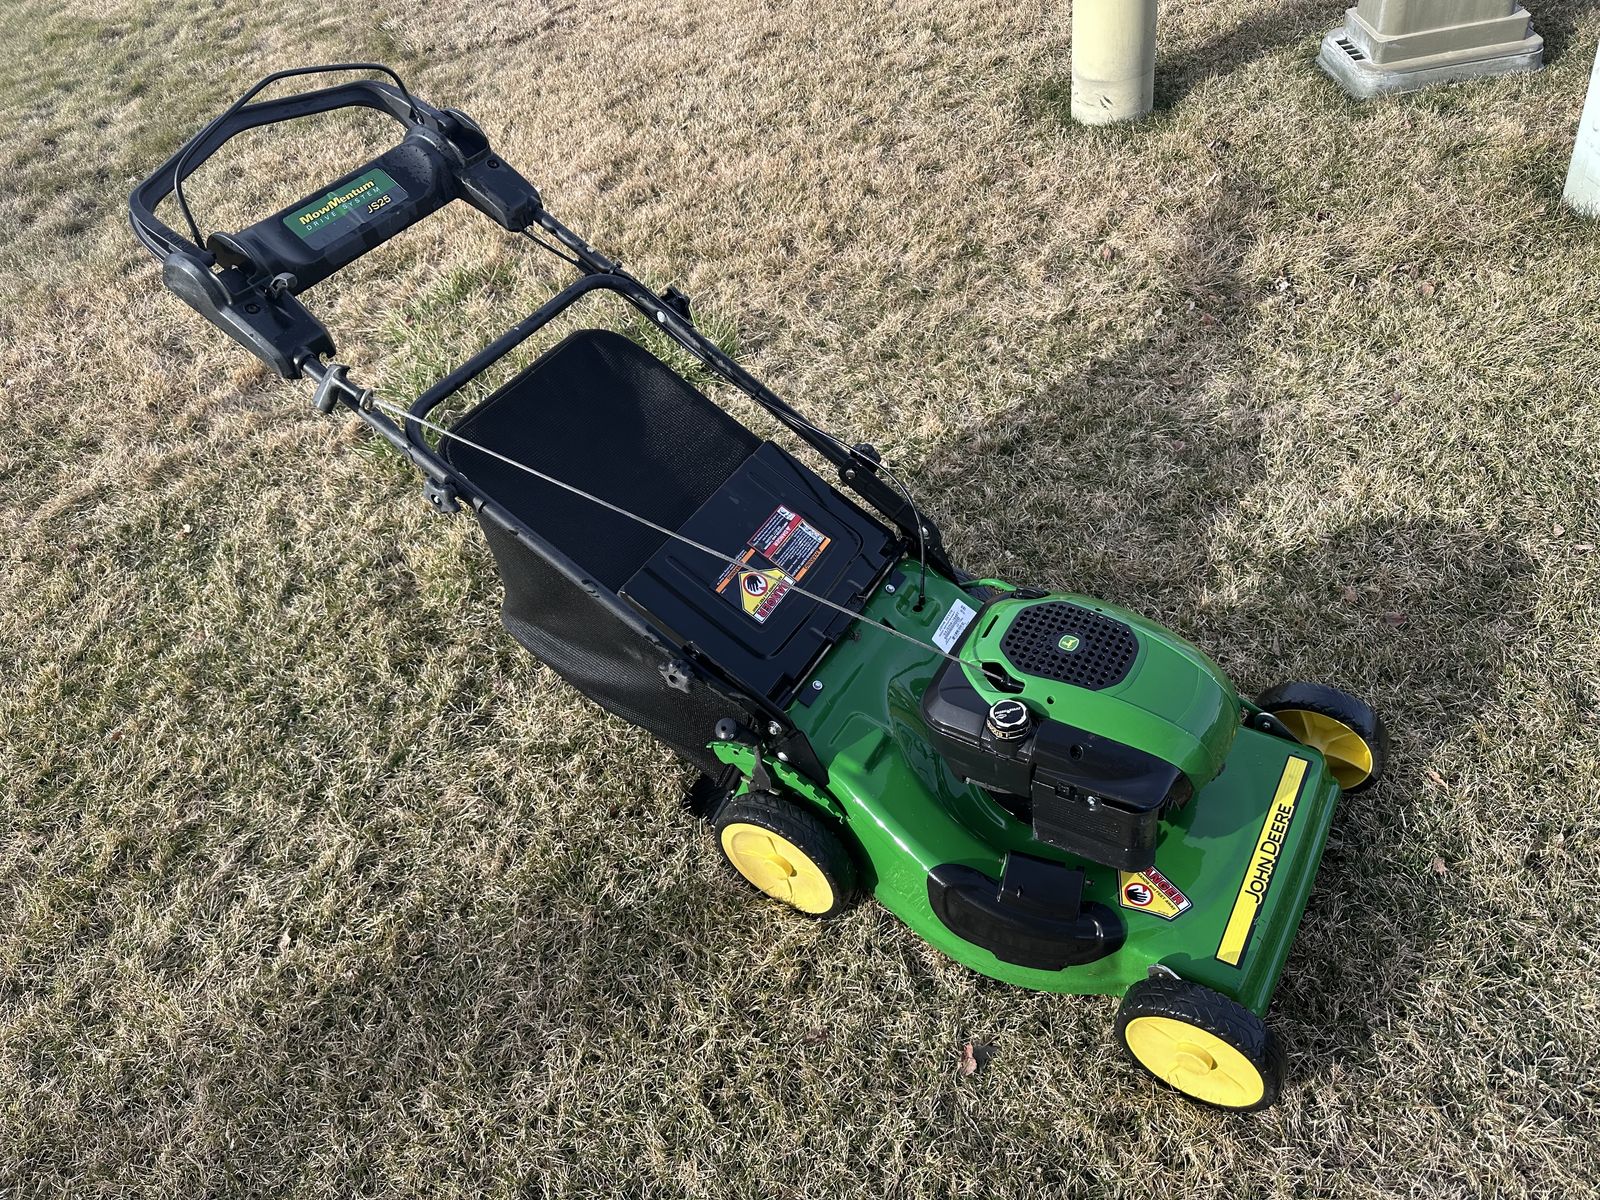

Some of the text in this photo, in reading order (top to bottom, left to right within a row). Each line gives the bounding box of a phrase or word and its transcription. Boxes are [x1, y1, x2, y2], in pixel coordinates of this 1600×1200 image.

[299, 180, 375, 225] MowMentum
[306, 187, 380, 231] DRIVE SYSTEM
[367, 195, 391, 214] JS25
[1245, 803, 1292, 903] JOHN DEERE
[1143, 866, 1185, 906] ANGER
